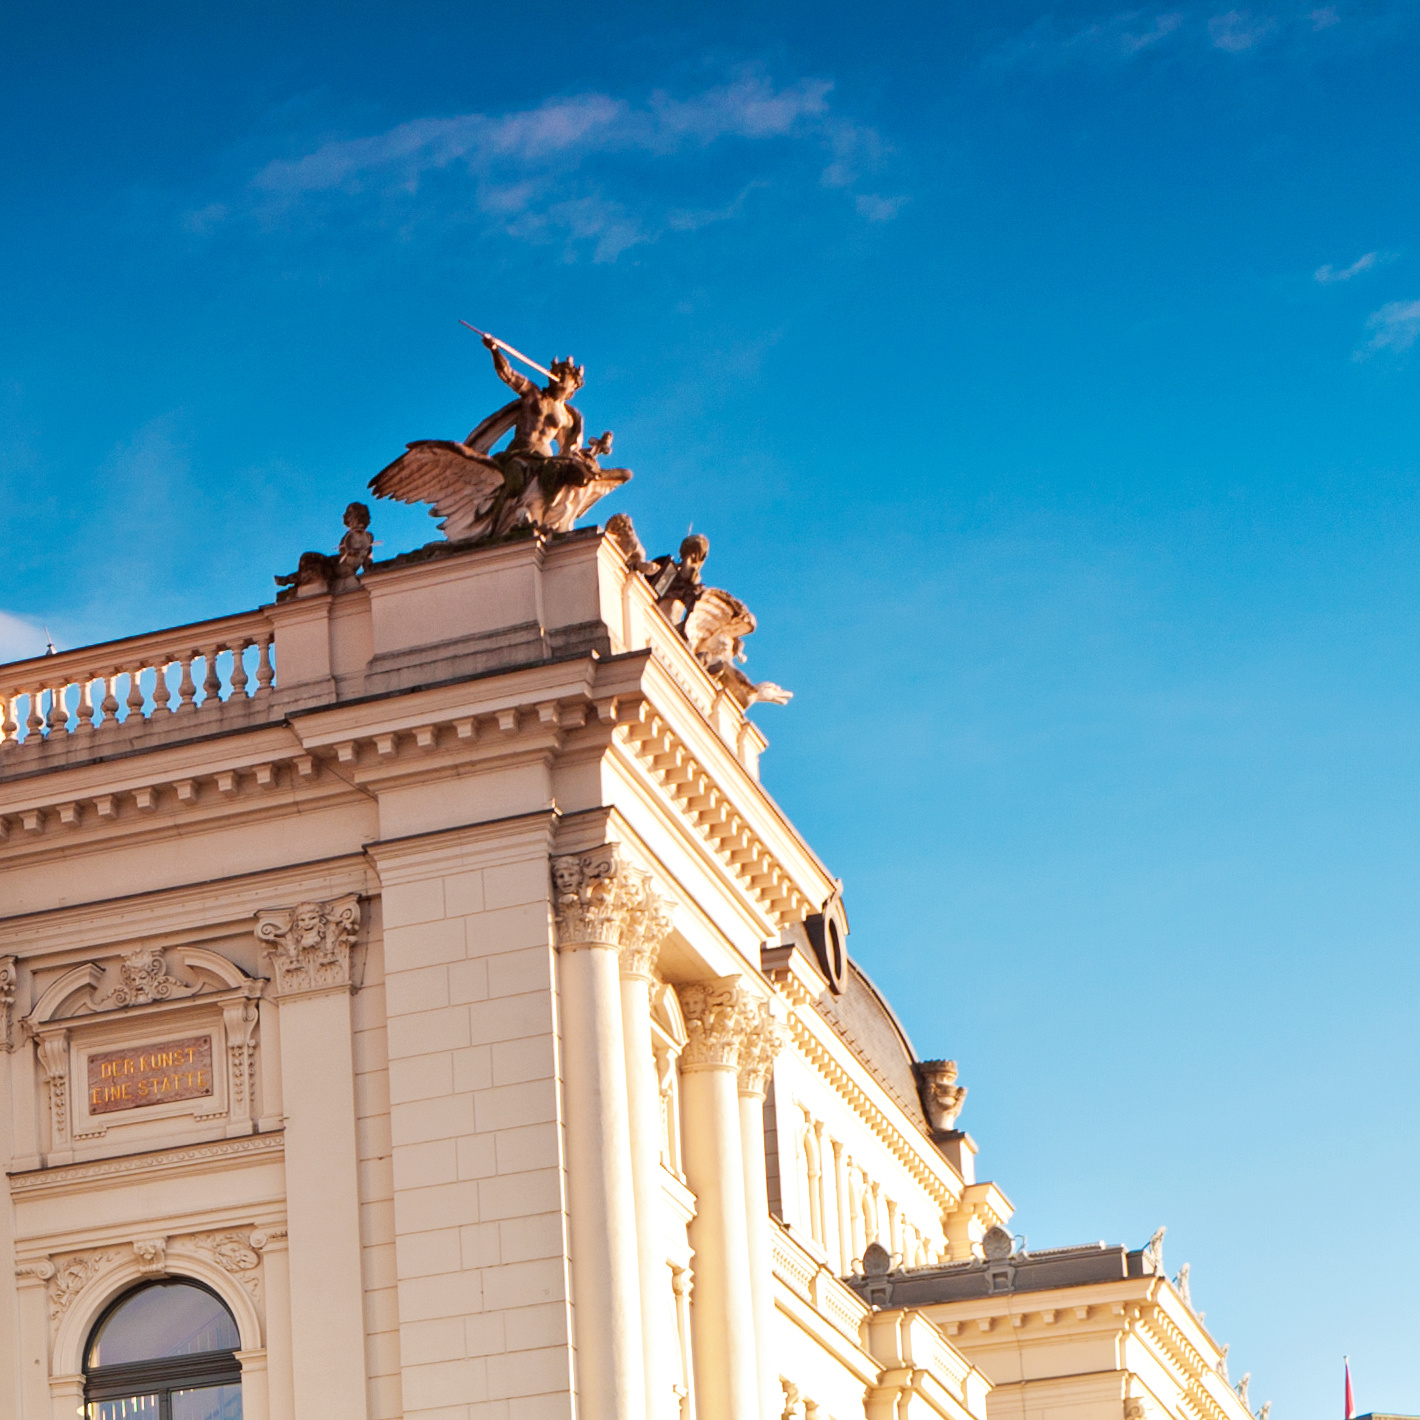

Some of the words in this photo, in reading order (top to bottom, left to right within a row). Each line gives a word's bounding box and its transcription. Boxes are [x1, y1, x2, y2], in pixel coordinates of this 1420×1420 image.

[101, 1058, 134, 1079] DER
[140, 1047, 196, 1072] KUNST
[92, 1082, 132, 1104] EINE
